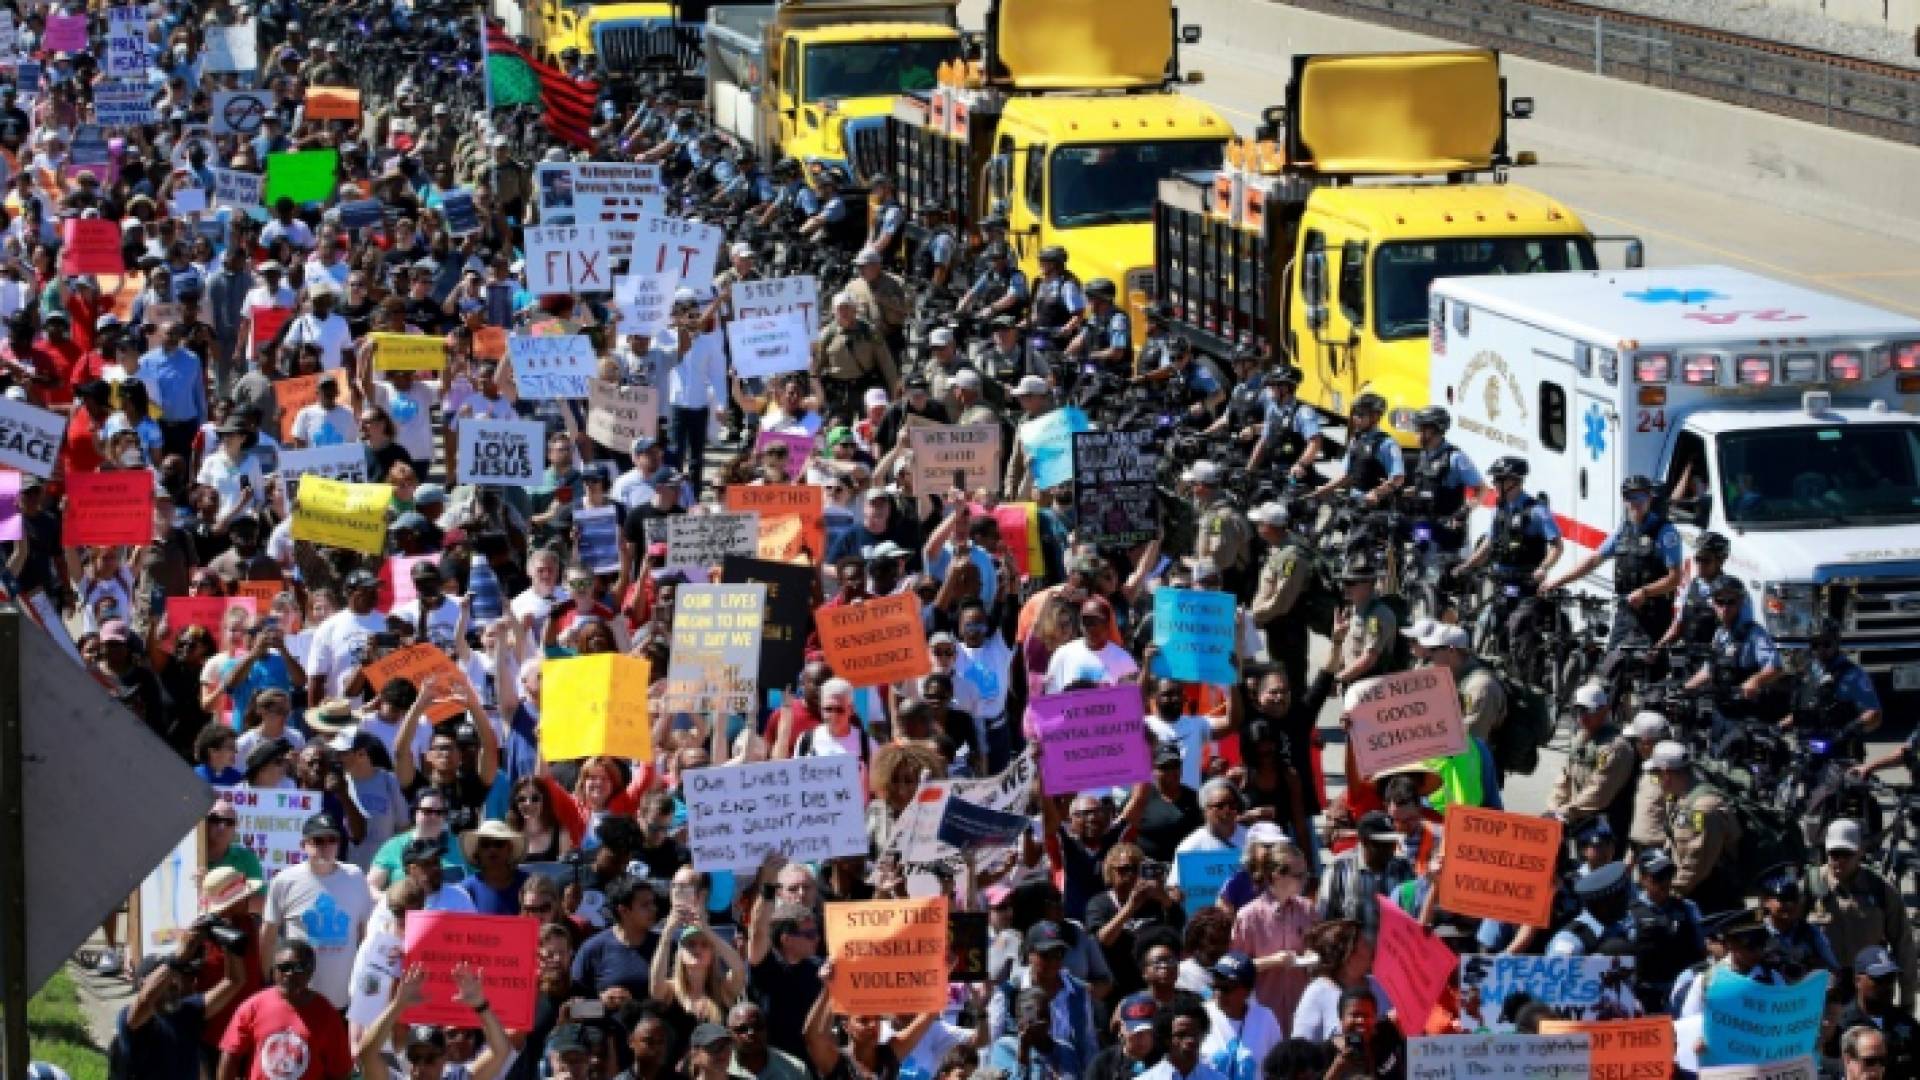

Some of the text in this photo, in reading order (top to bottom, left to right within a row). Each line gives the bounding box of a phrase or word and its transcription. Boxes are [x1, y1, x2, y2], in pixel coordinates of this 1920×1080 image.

[533, 229, 579, 243] STEP
[589, 228, 595, 240] 1
[649, 217, 693, 236] STEP
[545, 250, 600, 285] FIX
[656, 242, 700, 279] IT
[744, 282, 785, 300] STEP
[1637, 411, 1666, 432] 24
[0, 427, 55, 463] EACE
[925, 431, 988, 443] WE NEED
[474, 442, 528, 461] LOVE
[936, 452, 974, 461] GOOD
[470, 460, 532, 478] JESUS
[743, 490, 810, 502] STOP THIS
[683, 593, 756, 608] OUR LIVES
[717, 613, 736, 627] TO
[831, 611, 867, 626] STOP
[731, 632, 752, 646] WE
[834, 625, 911, 649] SENSELESS
[842, 650, 912, 672] VIOLENCE
[1390, 675, 1438, 695] NEED
[1377, 702, 1427, 724] GOOD
[1367, 720, 1448, 750] SCHOOLS
[276, 793, 312, 811] THE
[1463, 816, 1549, 843] STOP THIS
[1455, 845, 1546, 871] SENSELESS
[1454, 875, 1536, 899] VIOLENCE
[848, 906, 942, 926] STOP THIS
[1496, 956, 1583, 979] PEACE
[1618, 1028, 1661, 1048] THIS
